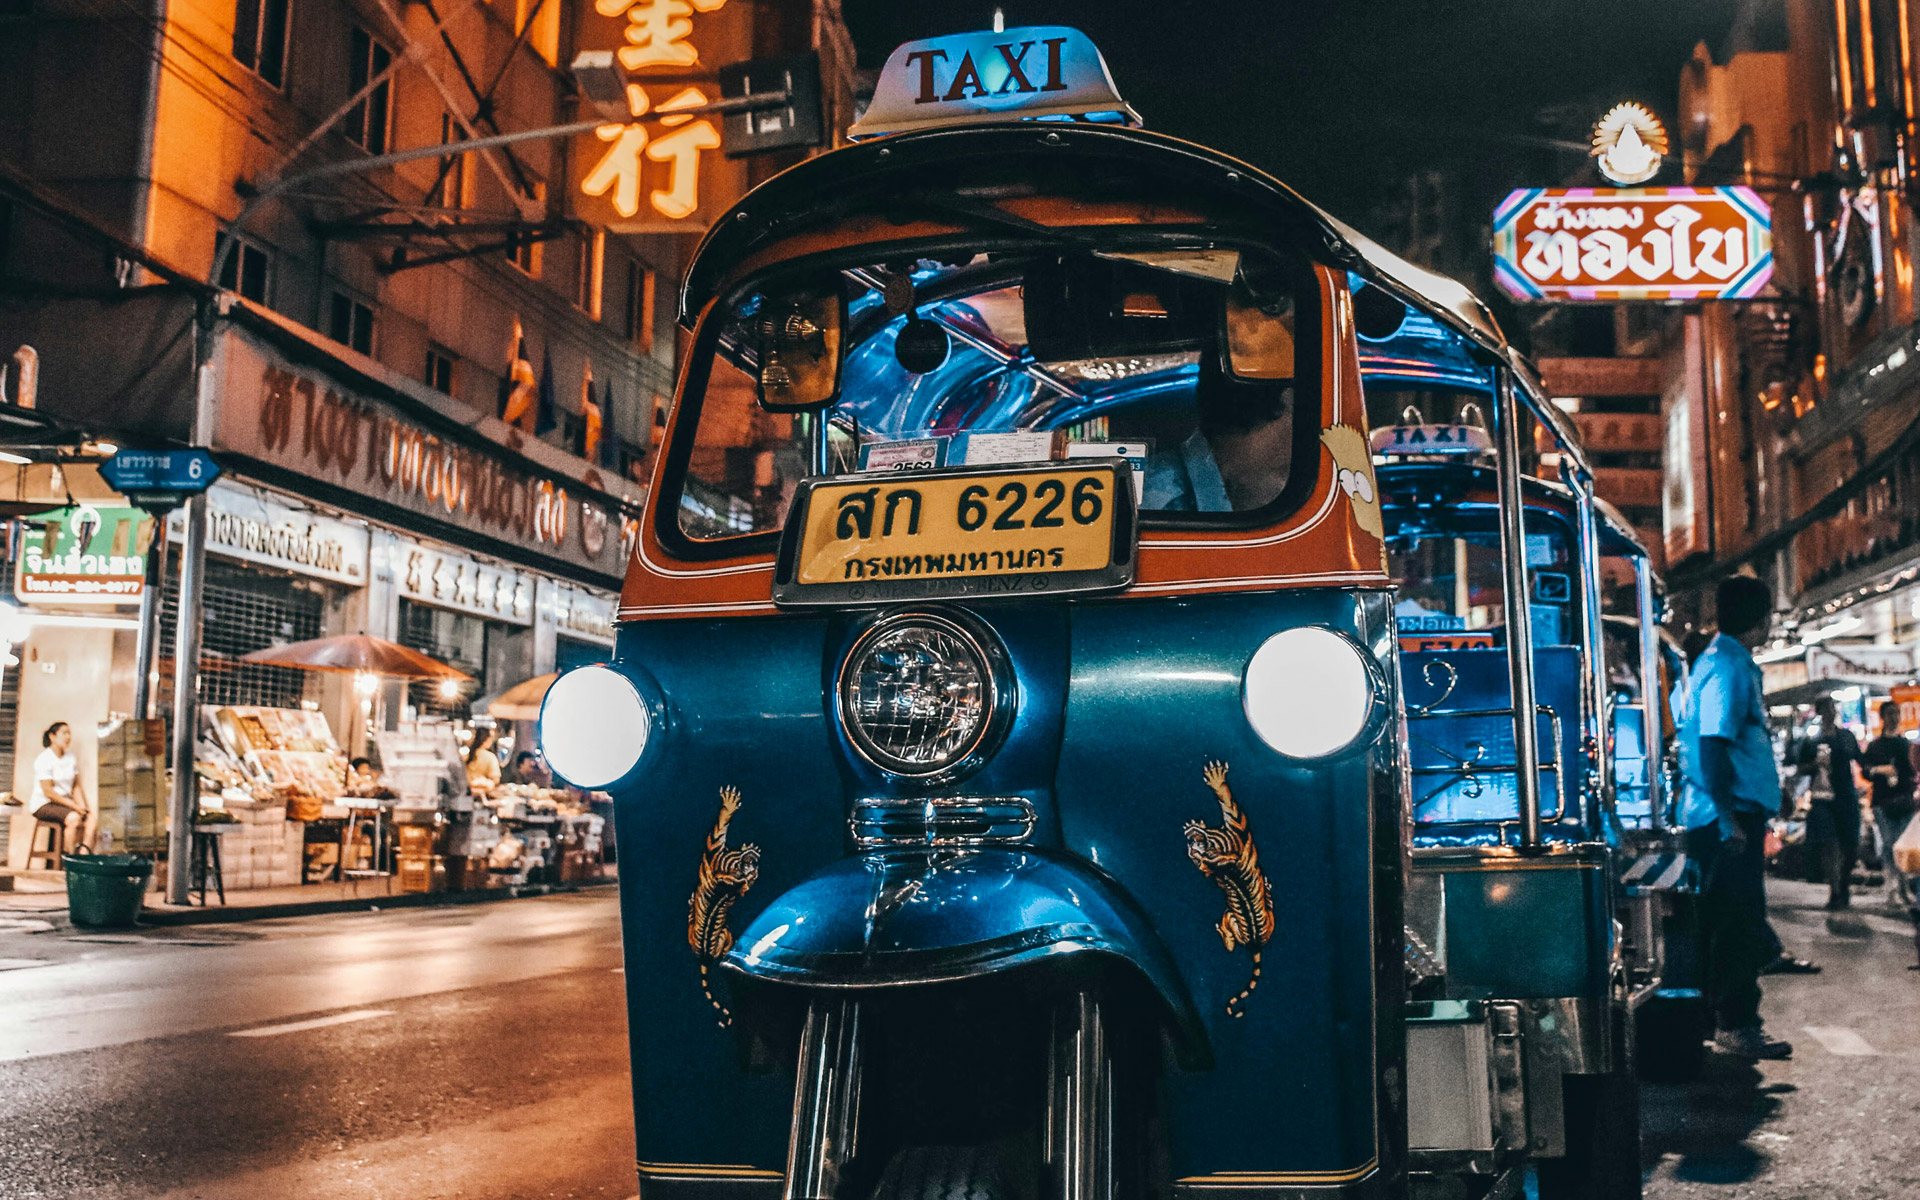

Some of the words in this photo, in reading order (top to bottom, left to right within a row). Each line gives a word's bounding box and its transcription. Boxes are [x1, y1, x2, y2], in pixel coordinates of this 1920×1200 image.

[905, 37, 1067, 104] TAXI
[1393, 427, 1468, 445] TAXI
[188, 458, 203, 480] 6
[836, 487, 923, 541] สก
[956, 477, 1104, 533] 6226
[844, 547, 1064, 579] กรงเทพมหานคร
